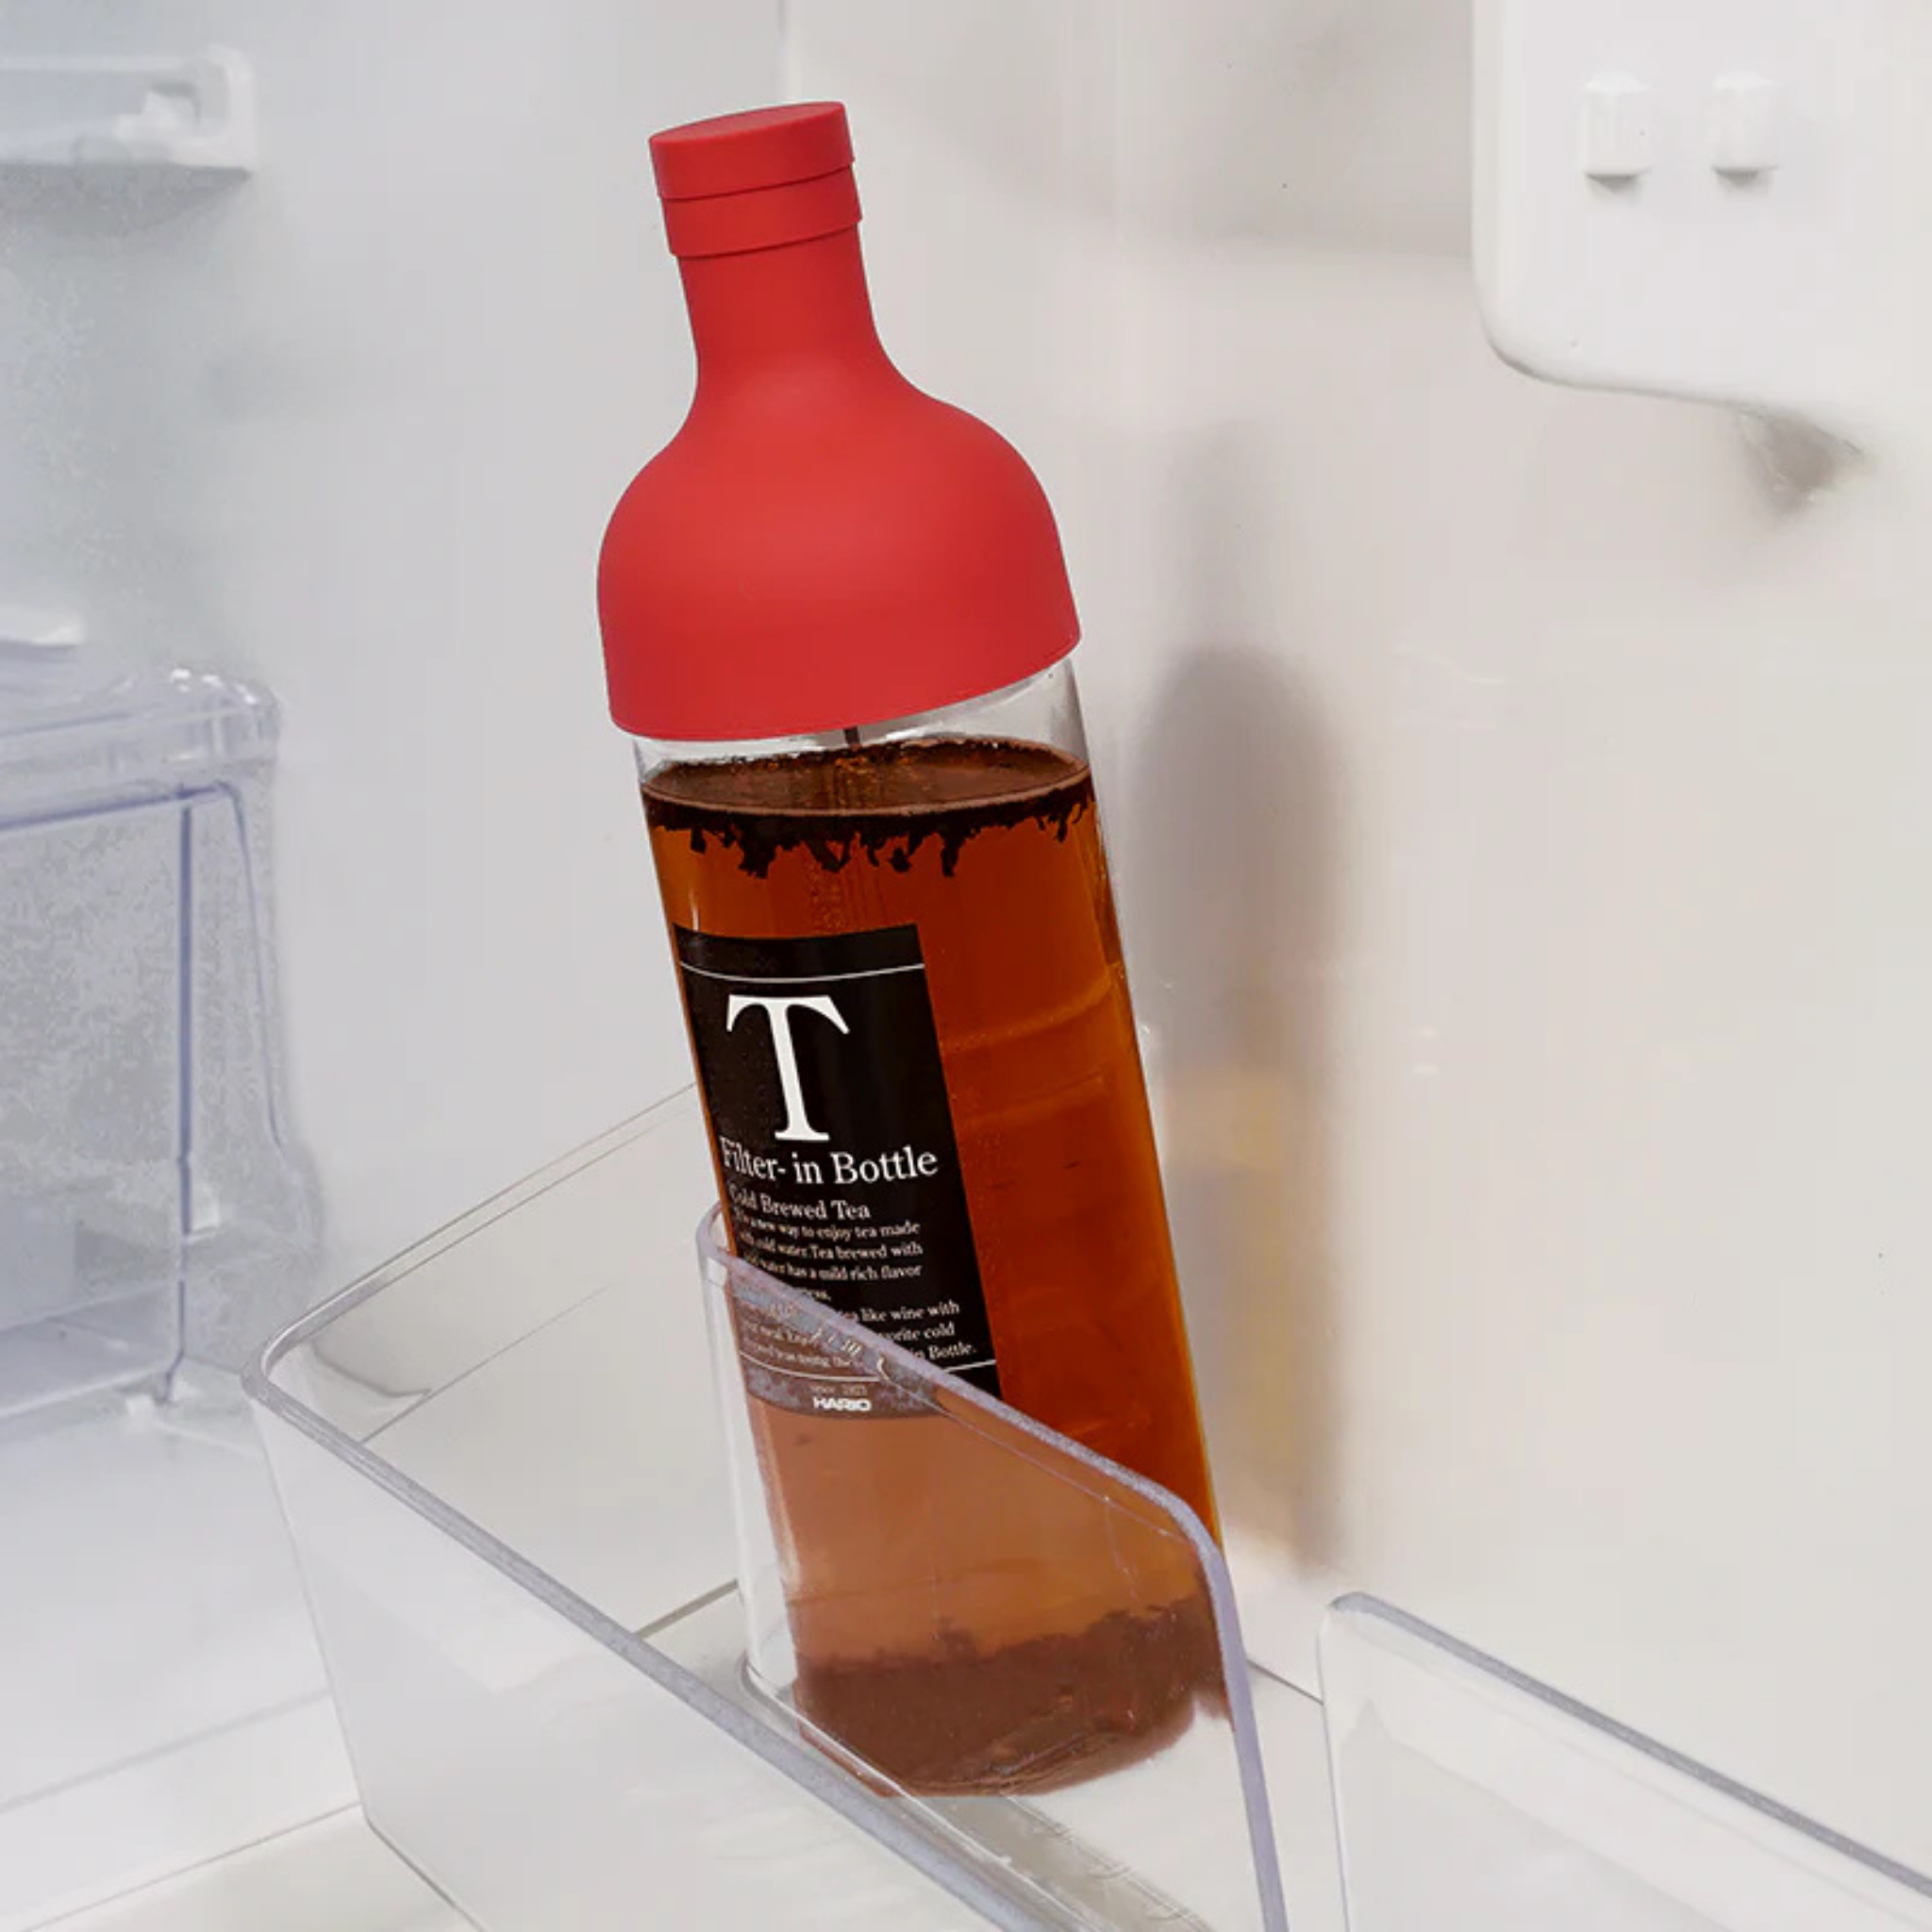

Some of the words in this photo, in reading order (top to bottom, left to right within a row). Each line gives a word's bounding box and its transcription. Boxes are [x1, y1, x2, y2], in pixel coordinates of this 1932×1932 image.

[725, 993, 851, 1141] T
[791, 1152, 824, 1184] in
[829, 1144, 939, 1184] Bottle
[759, 1192, 828, 1219] Brewed
[830, 1199, 871, 1220] Tea
[801, 1225, 814, 1237] to
[816, 1224, 852, 1241] enjoy
[854, 1226, 877, 1239] tea
[878, 1219, 921, 1237] made
[834, 1243, 888, 1259] brewed
[890, 1241, 924, 1257] with
[787, 1261, 808, 1278] has
[818, 1263, 848, 1281] mild
[849, 1263, 880, 1281] rich
[881, 1264, 923, 1280] flavor
[859, 1307, 887, 1323] like
[890, 1306, 924, 1320] wine
[926, 1299, 960, 1316] with
[924, 1322, 956, 1339] cold
[928, 1341, 977, 1359] Bottle.
